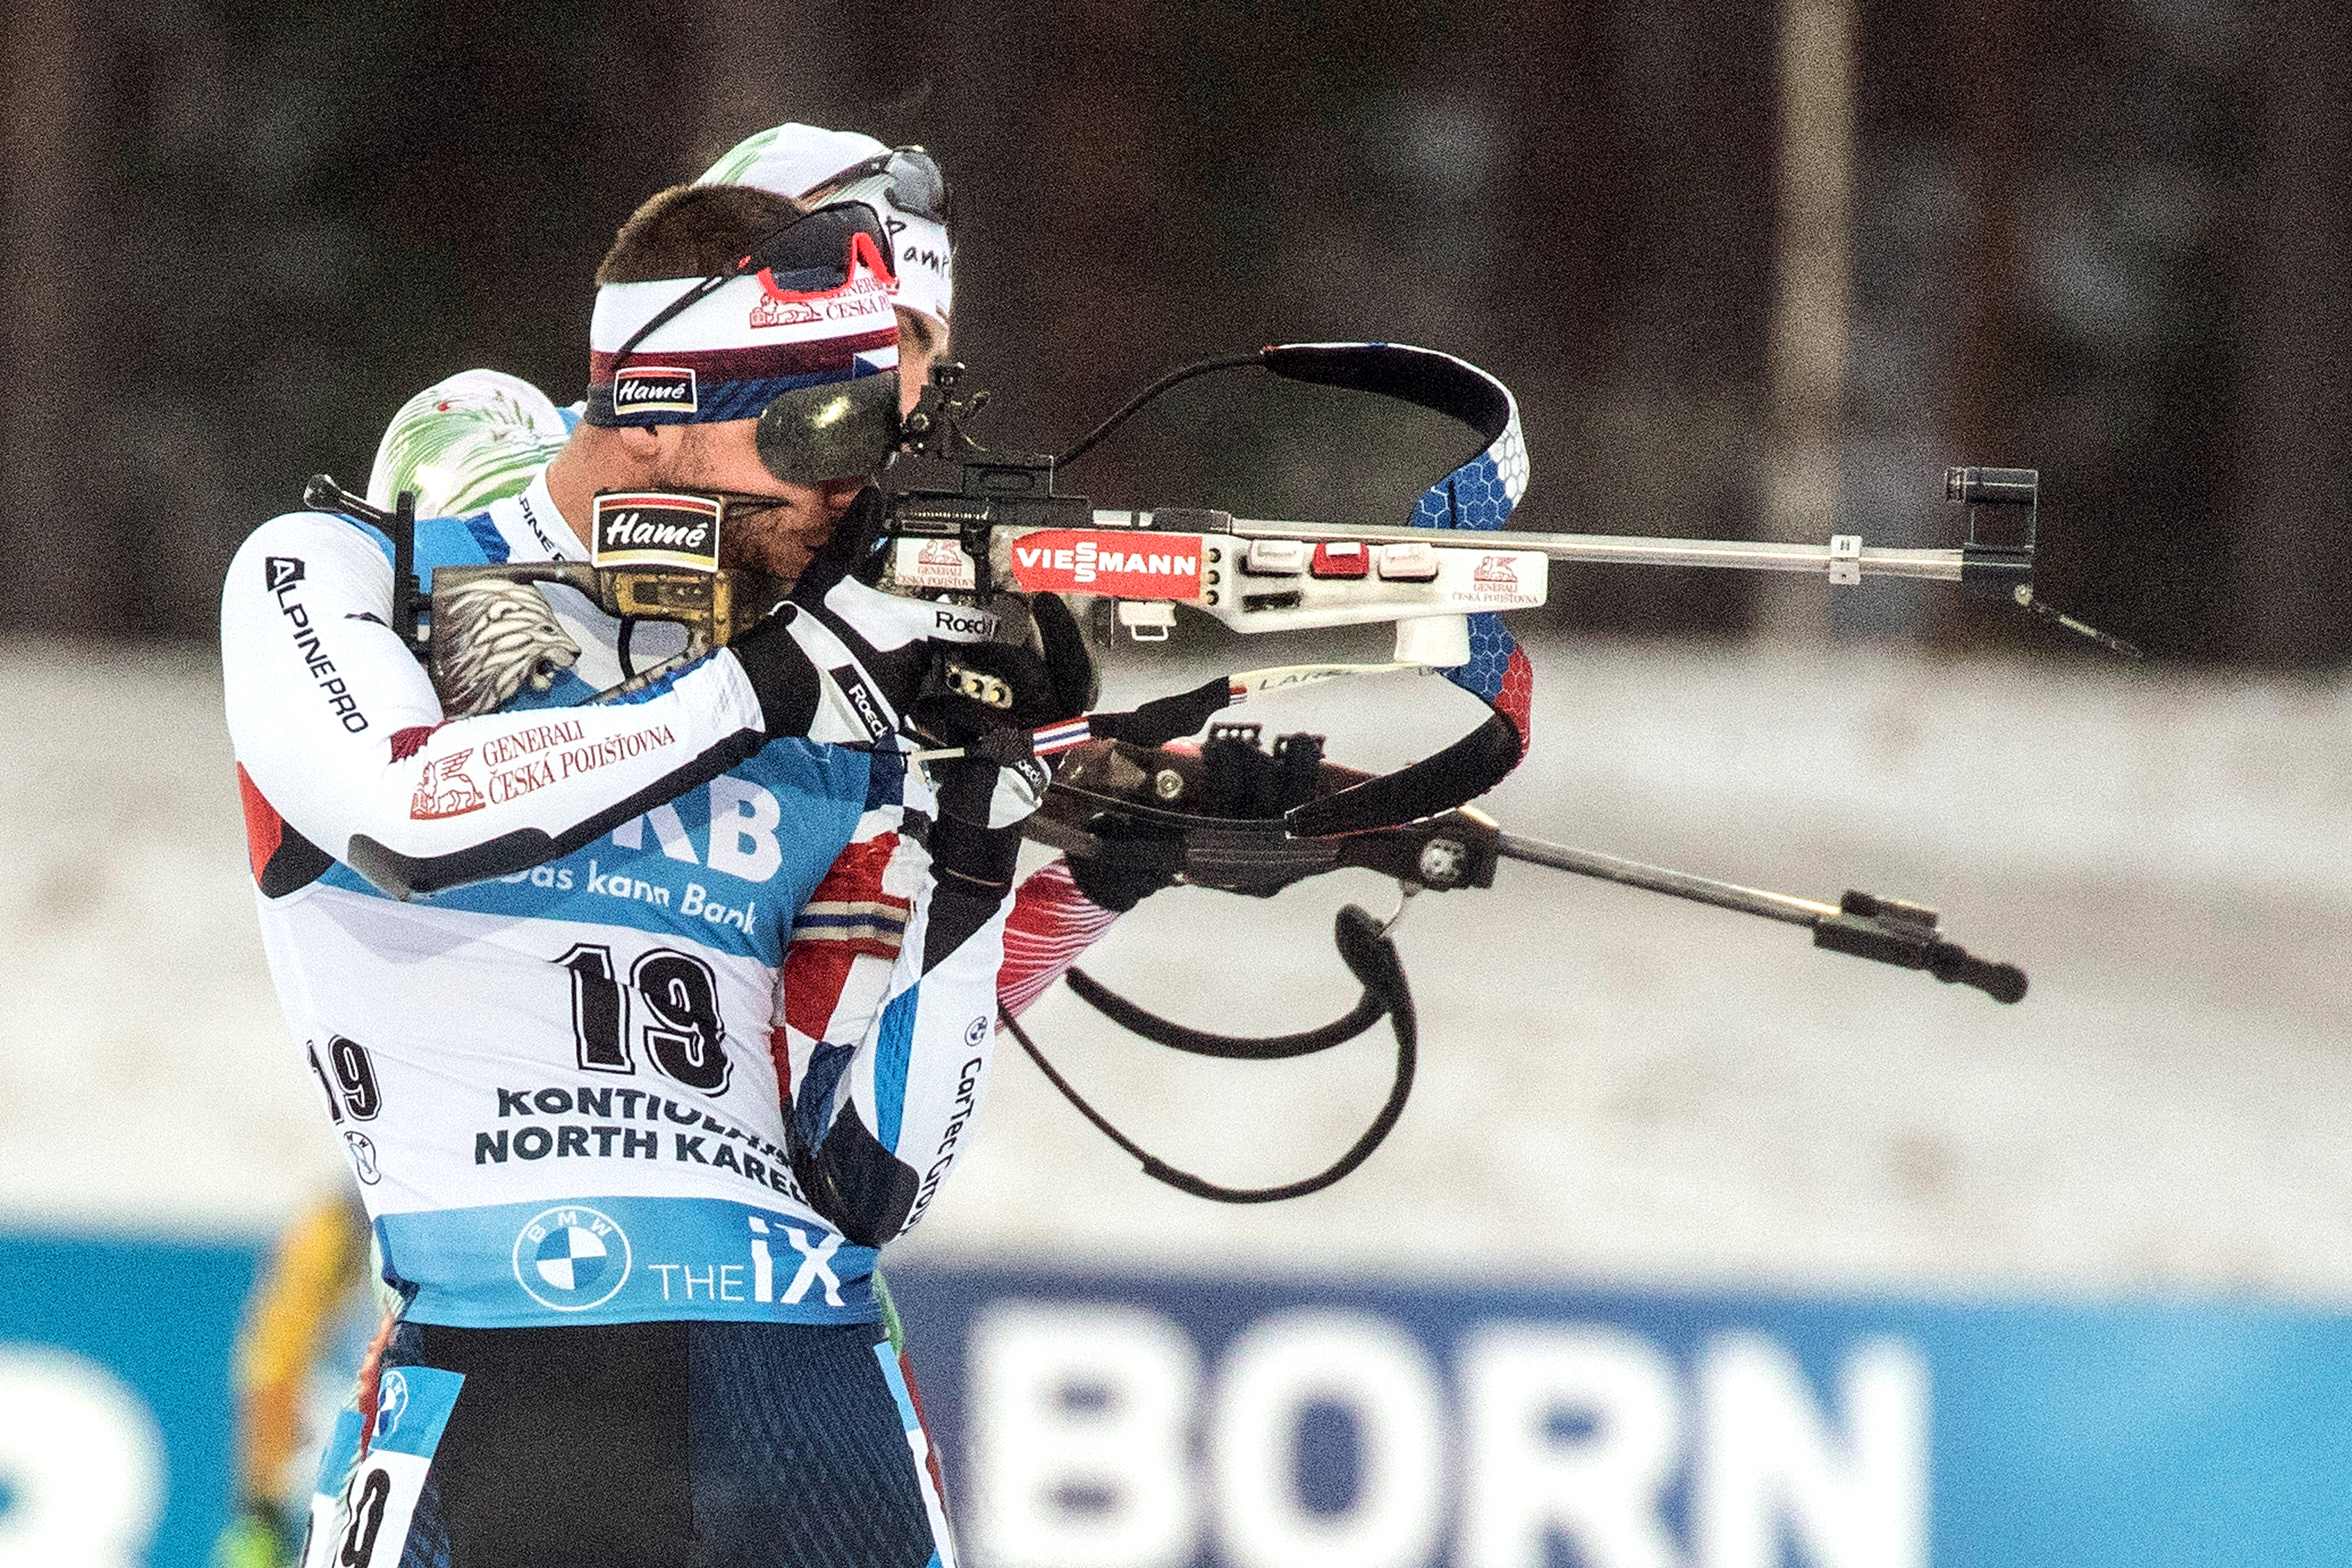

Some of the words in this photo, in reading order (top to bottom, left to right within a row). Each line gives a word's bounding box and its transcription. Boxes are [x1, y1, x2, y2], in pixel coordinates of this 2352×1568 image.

[618, 379, 686, 401] Hamé
[607, 512, 709, 547] Hamé
[1017, 542, 1196, 582] VIESSMANN
[268, 557, 336, 679] ALPINE
[319, 677, 369, 733] PRO
[482, 720, 585, 767] GENERALI
[489, 752, 556, 804] ČESKÁ
[559, 725, 676, 779] POJIŠŤOVNA
[587, 859, 670, 909] kann
[680, 882, 756, 936] Bank
[553, 942, 733, 1098] 19
[306, 1034, 382, 1126] 19
[936, 1057, 982, 1155] CarTec
[475, 1126, 658, 1165] NORTH
[527, 1211, 612, 1243] BMW
[648, 1264, 745, 1301] THE
[748, 1216, 846, 1307] iX
[968, 1300, 1930, 1568] BORN
